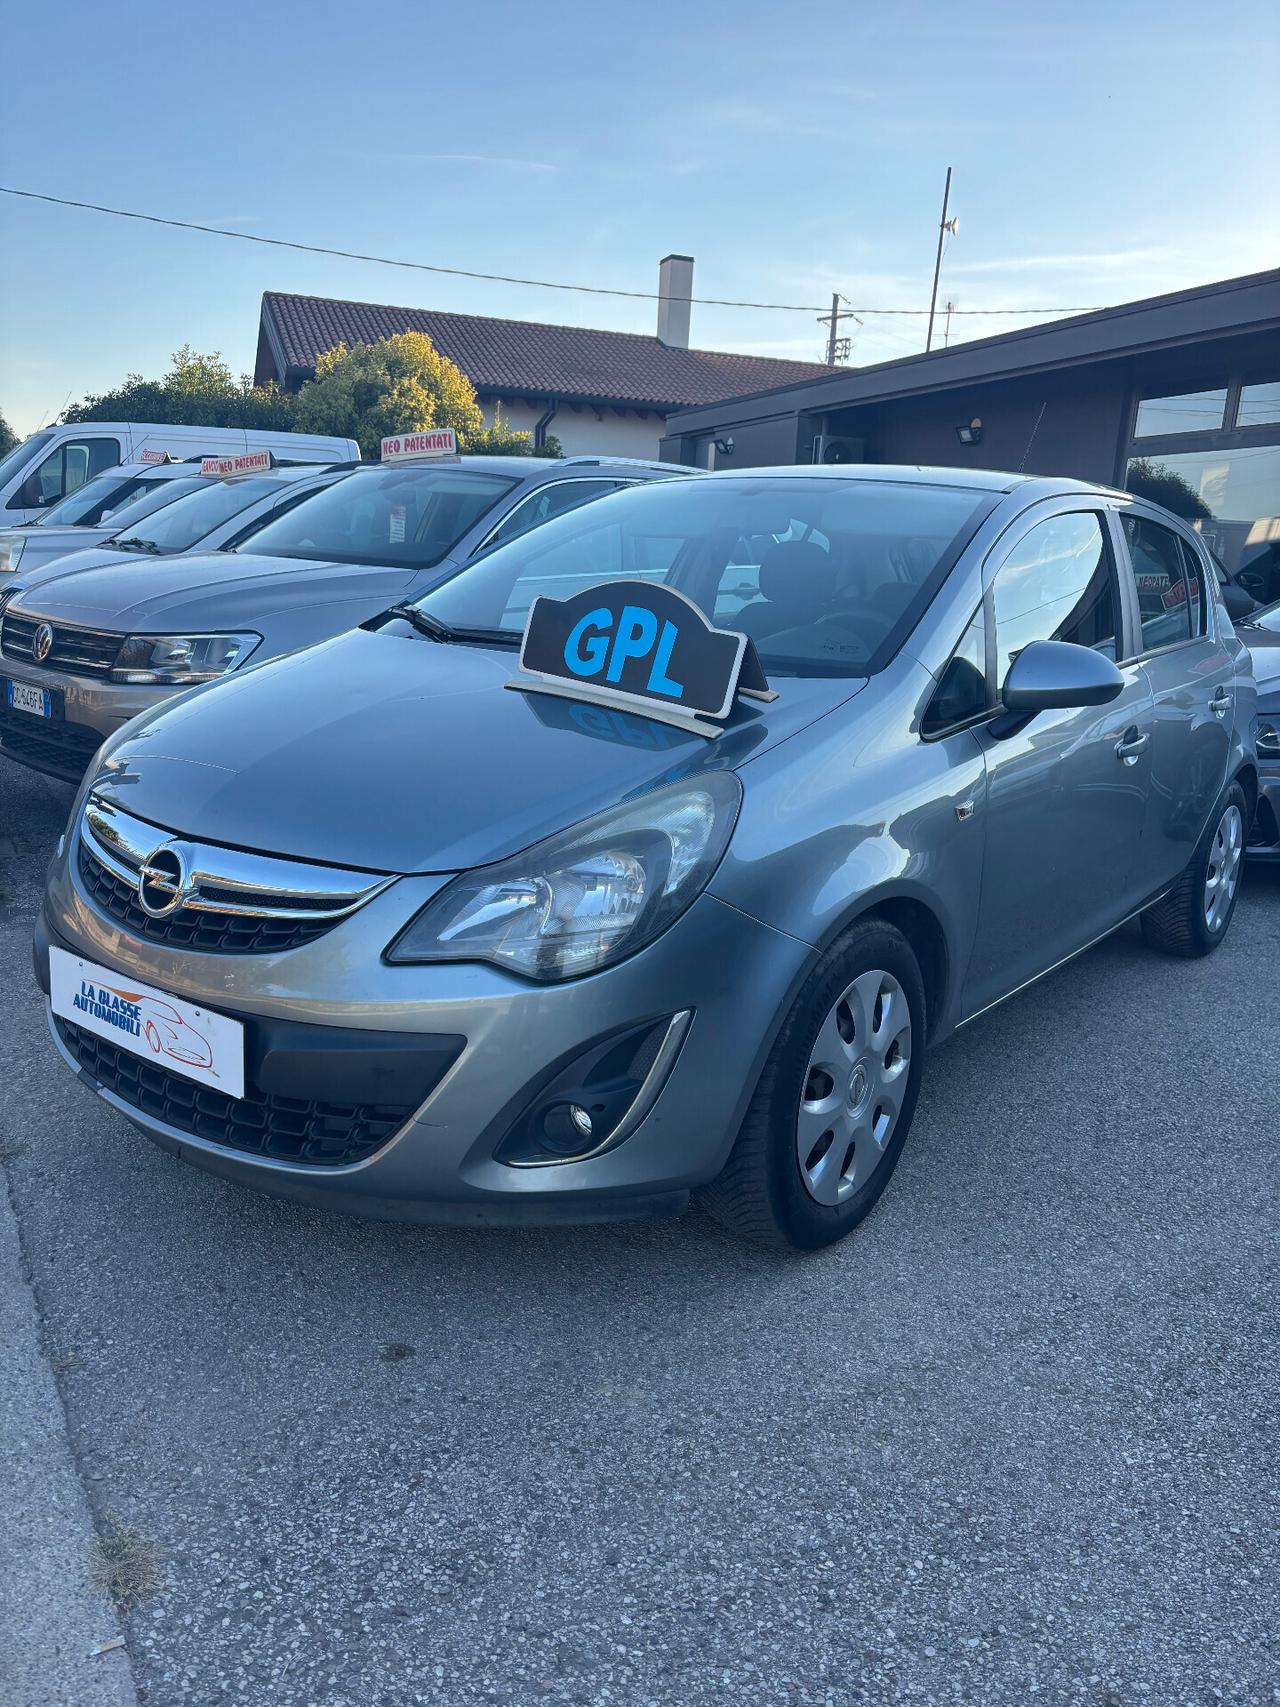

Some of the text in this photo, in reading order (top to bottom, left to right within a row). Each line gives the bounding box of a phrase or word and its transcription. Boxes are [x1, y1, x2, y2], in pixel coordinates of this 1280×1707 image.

[383, 432, 453, 455] NEO PATENTATI
[220, 453, 267, 474] NEO PATENTATI
[563, 605, 684, 699] GPL
[81, 980, 95, 1001] LA
[73, 993, 141, 1037] AUTOMOBILI
